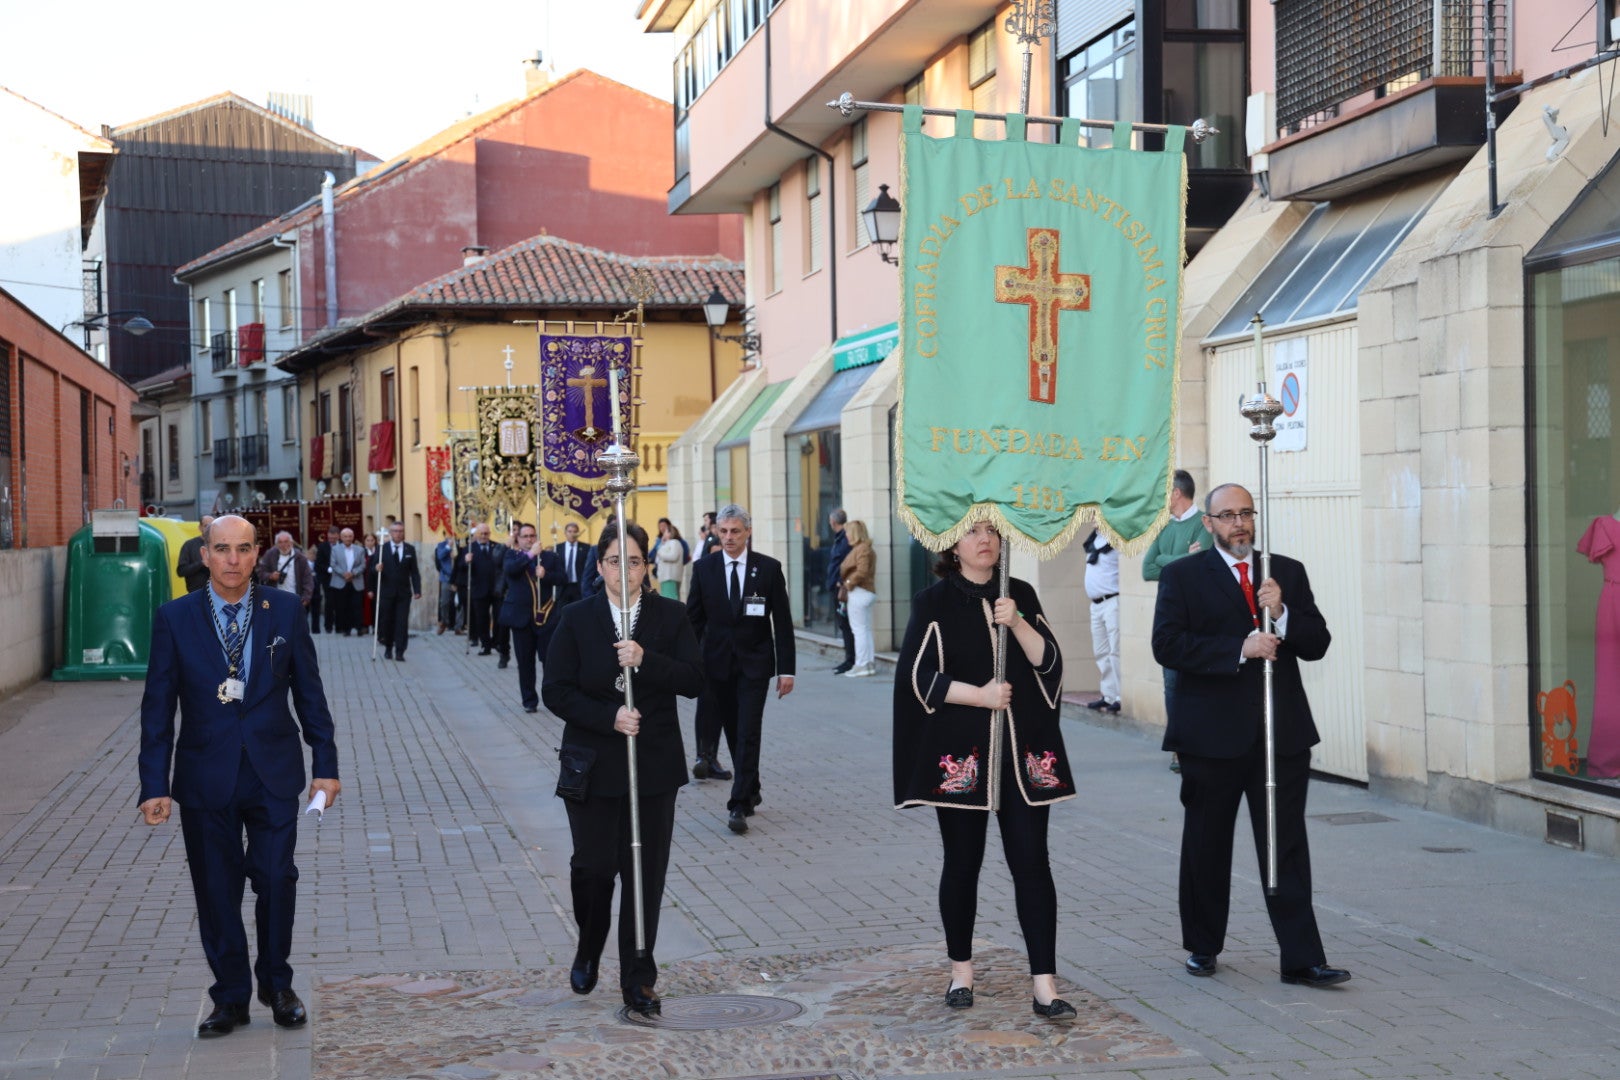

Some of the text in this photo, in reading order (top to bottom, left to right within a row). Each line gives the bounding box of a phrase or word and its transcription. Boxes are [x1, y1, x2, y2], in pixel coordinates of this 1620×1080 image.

[915, 177, 1169, 371] COFRADIA DE LA SANTISIMA CRUZ
[930, 427, 1149, 461] FUNDADA EN
